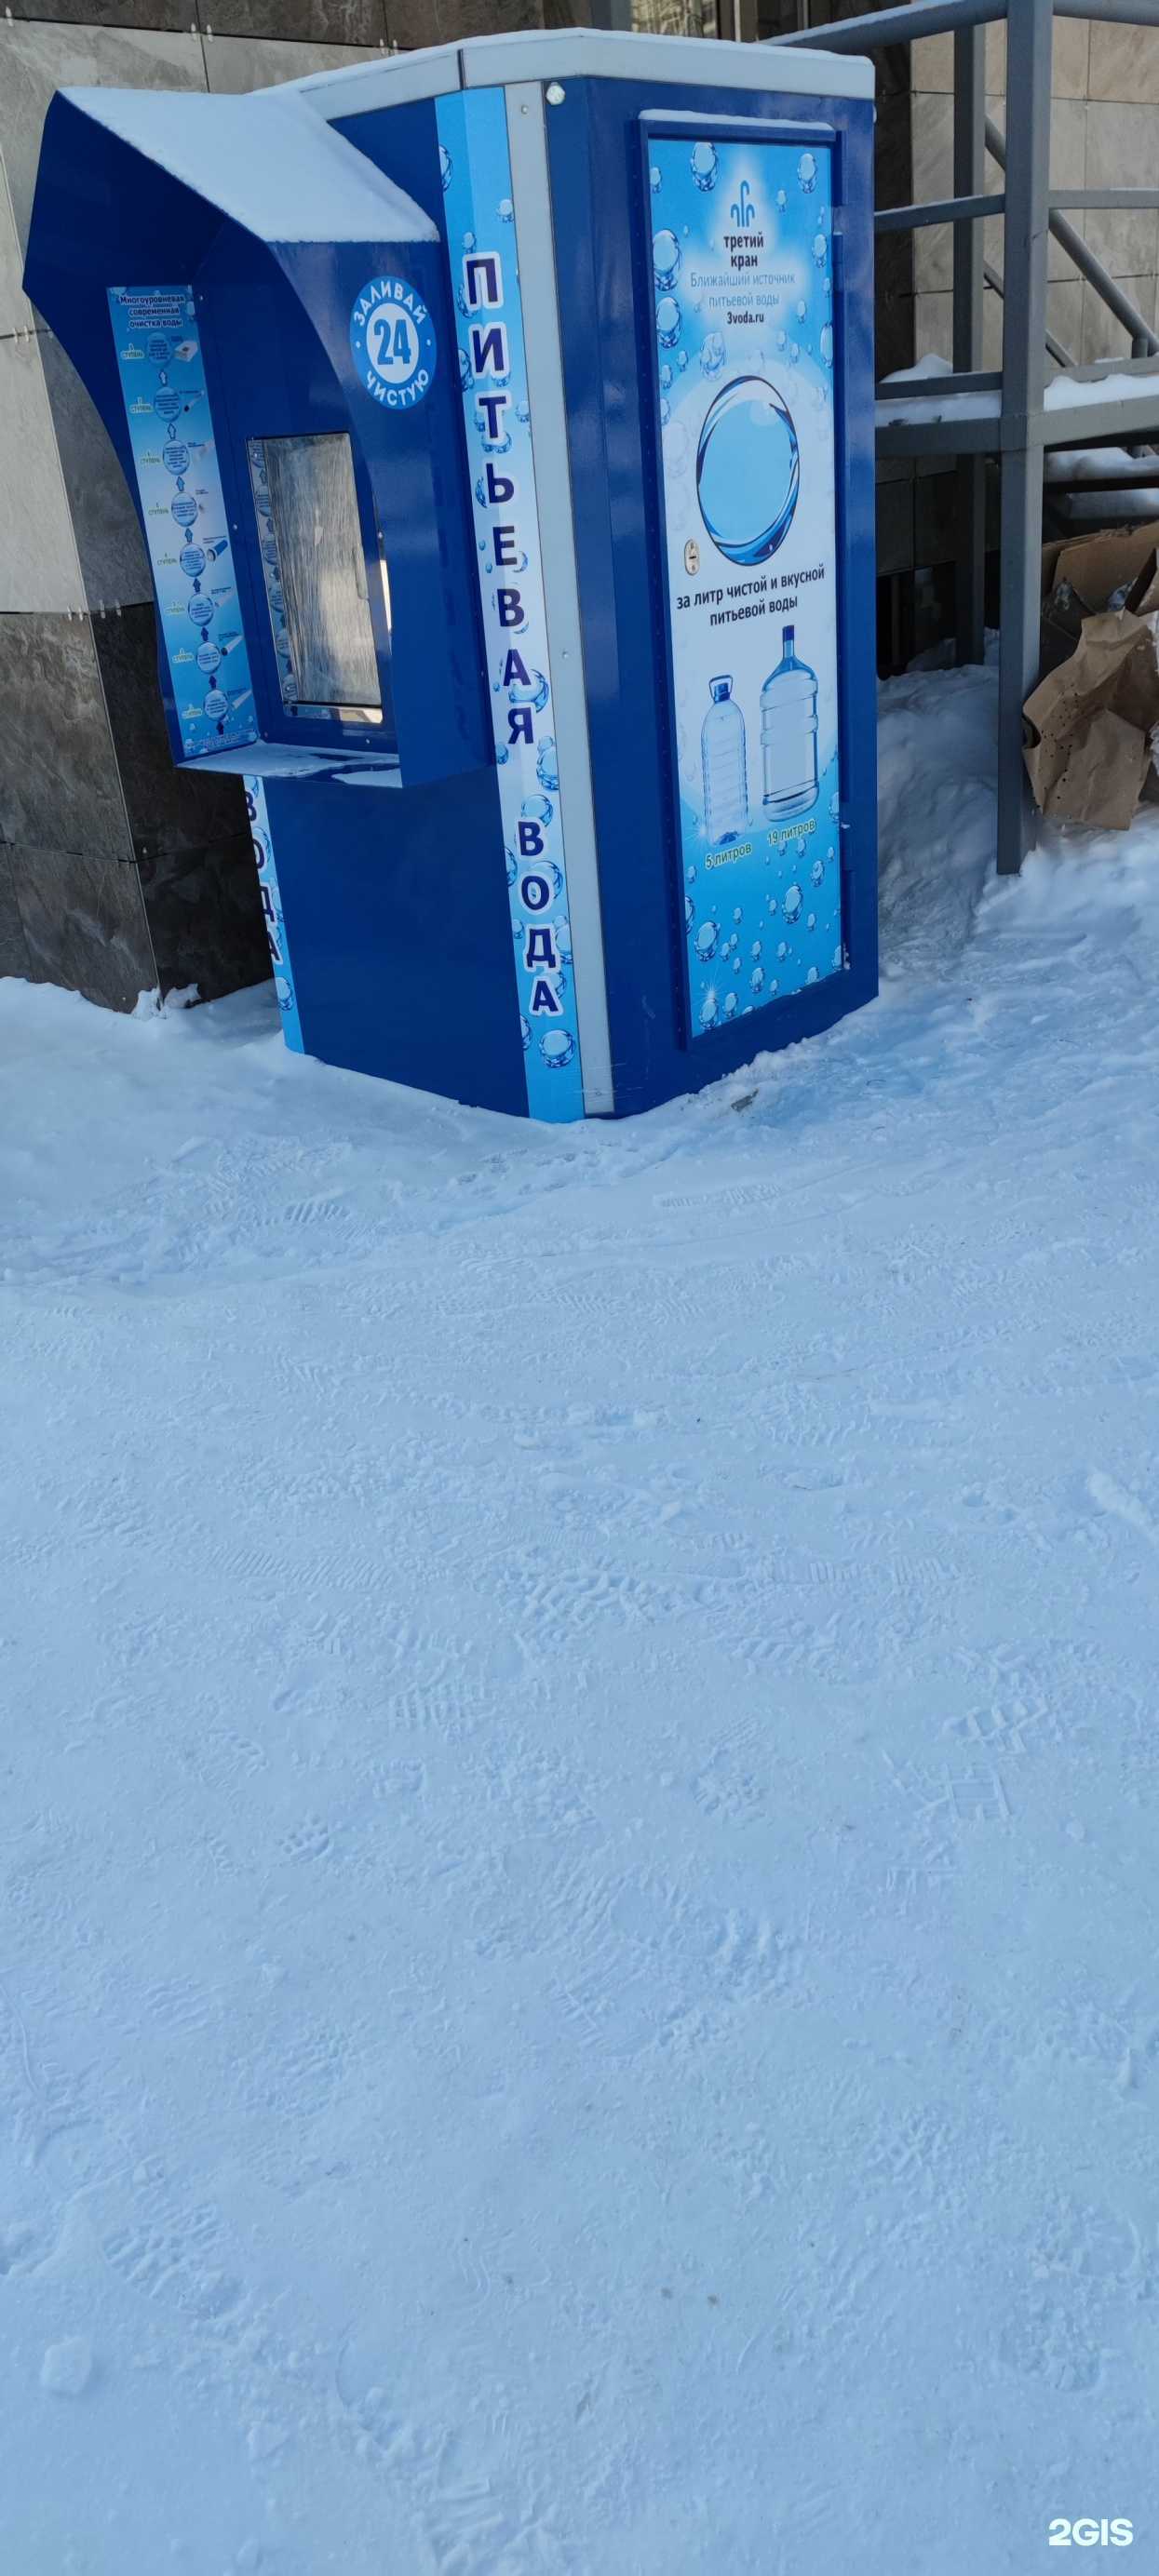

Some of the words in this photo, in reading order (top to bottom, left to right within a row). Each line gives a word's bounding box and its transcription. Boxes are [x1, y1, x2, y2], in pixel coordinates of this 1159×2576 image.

[723, 232, 764, 251] третий
[731, 254, 758, 271] кран
[690, 272, 750, 288] Ближайший
[752, 274, 796, 286] источник
[354, 280, 428, 327] ЗАЛИВАЙ
[708, 293, 753, 307] питьевой
[756, 296, 779, 306] воды
[727, 312, 764, 325] 3voda.ru
[373, 317, 411, 365] 24
[367, 369, 429, 406] ЧИСТУЮ
[676, 595, 691, 610] за
[694, 588, 723, 607] литр
[726, 575, 767, 599] чистой
[771, 579, 778, 590] и
[781, 563, 825, 589] вкусной
[709, 598, 766, 626] питьевой
[769, 596, 798, 613] воды
[465, 257, 534, 745] ПИТЬЕВАЯ
[518, 821, 559, 1013] ВОДА
[768, 831, 778, 845] 19
[781, 820, 815, 840] литров
[706, 854, 712, 868] 5
[714, 843, 751, 865] литров
